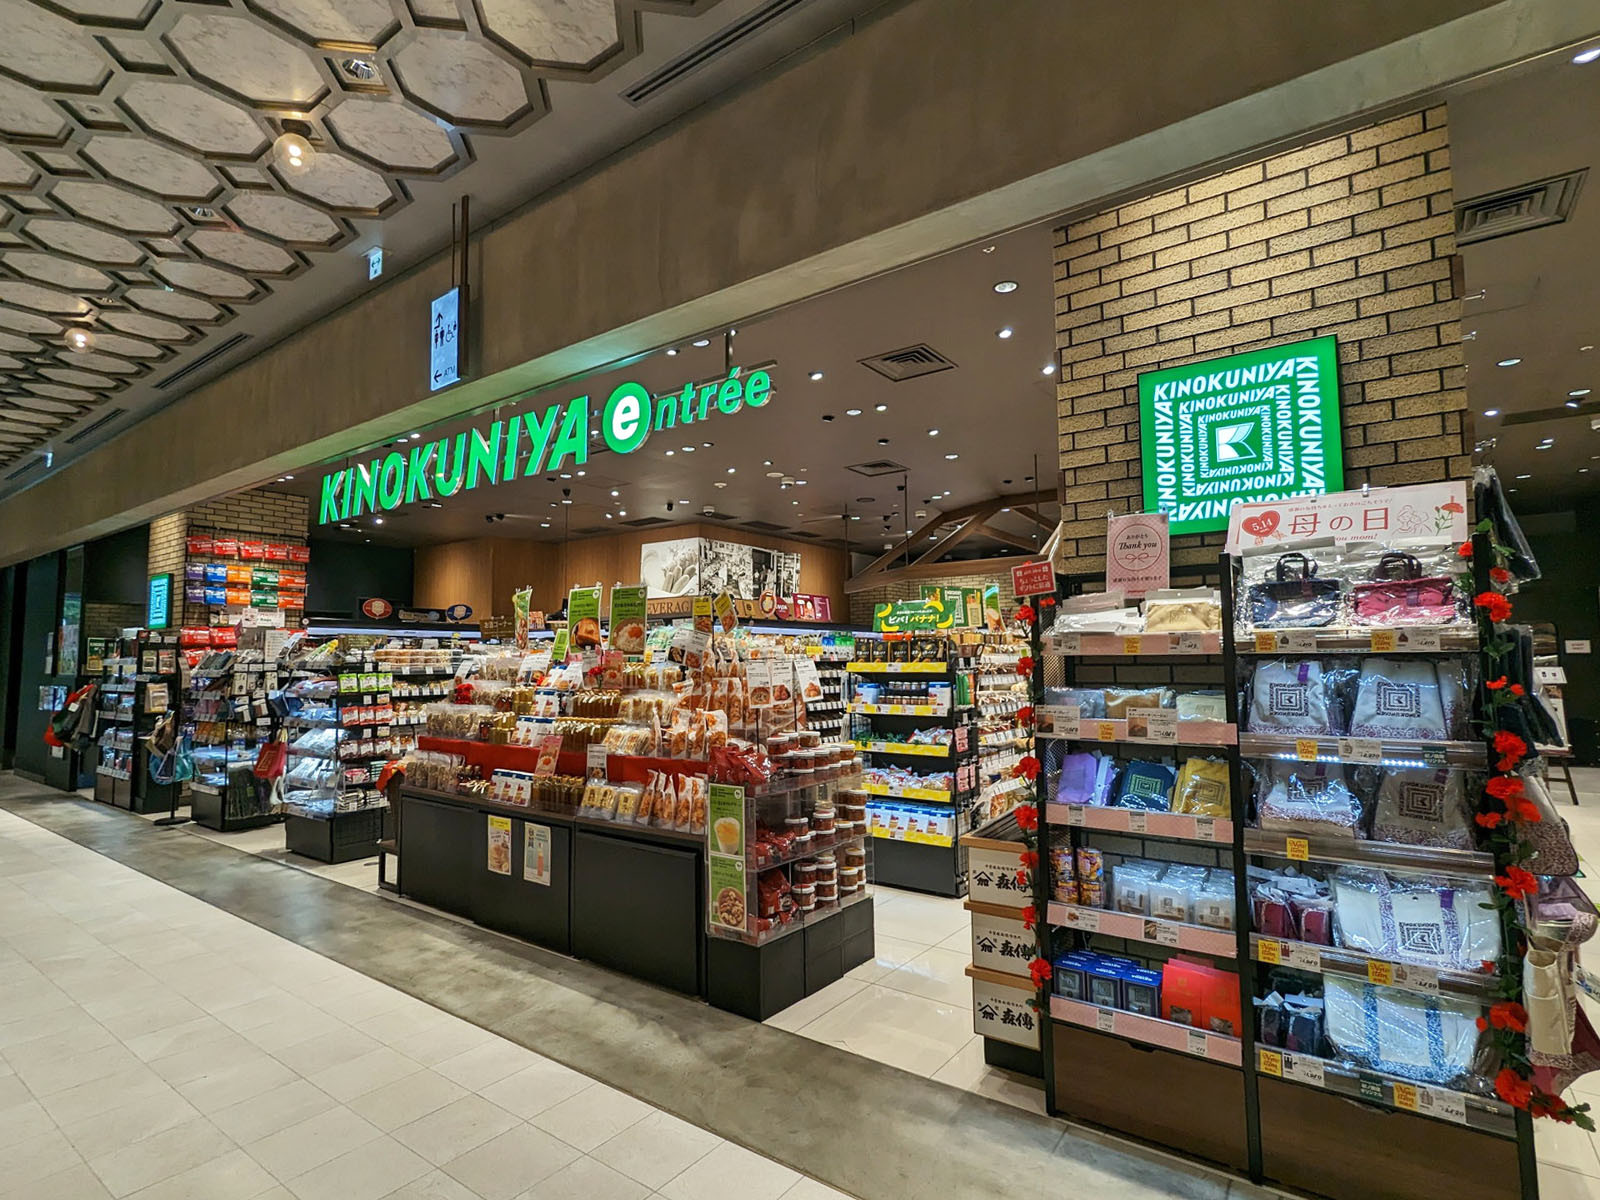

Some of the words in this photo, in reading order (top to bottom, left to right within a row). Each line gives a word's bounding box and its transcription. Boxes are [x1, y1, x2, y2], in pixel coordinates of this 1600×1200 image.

[1154, 358, 1296, 401] KINOKUNIYA
[1179, 386, 1276, 414] KINOKUNIYA
[1198, 406, 1261, 424] KINOKUNIYA
[1260, 405, 1274, 463] KINOKUNIYA
[1276, 384, 1295, 473] KINOKUNIYA
[1296, 356, 1326, 488] KINOKUNIYA
[319, 395, 590, 525] KINOKUNIYA
[609, 366, 771, 442] entrée
[1179, 413, 1196, 497] KINOKUNIYA
[1198, 423, 1209, 478] KINOKUNIYA
[1195, 472, 1295, 497] KINOKUNIYA
[1208, 461, 1274, 478] KINOKUNIYA
[1252, 518, 1273, 531] 5.14
[1288, 507, 1389, 538] 母の日
[1118, 540, 1142, 550] Thank
[1142, 542, 1158, 551] you
[1000, 1007, 1035, 1031] 森傳
